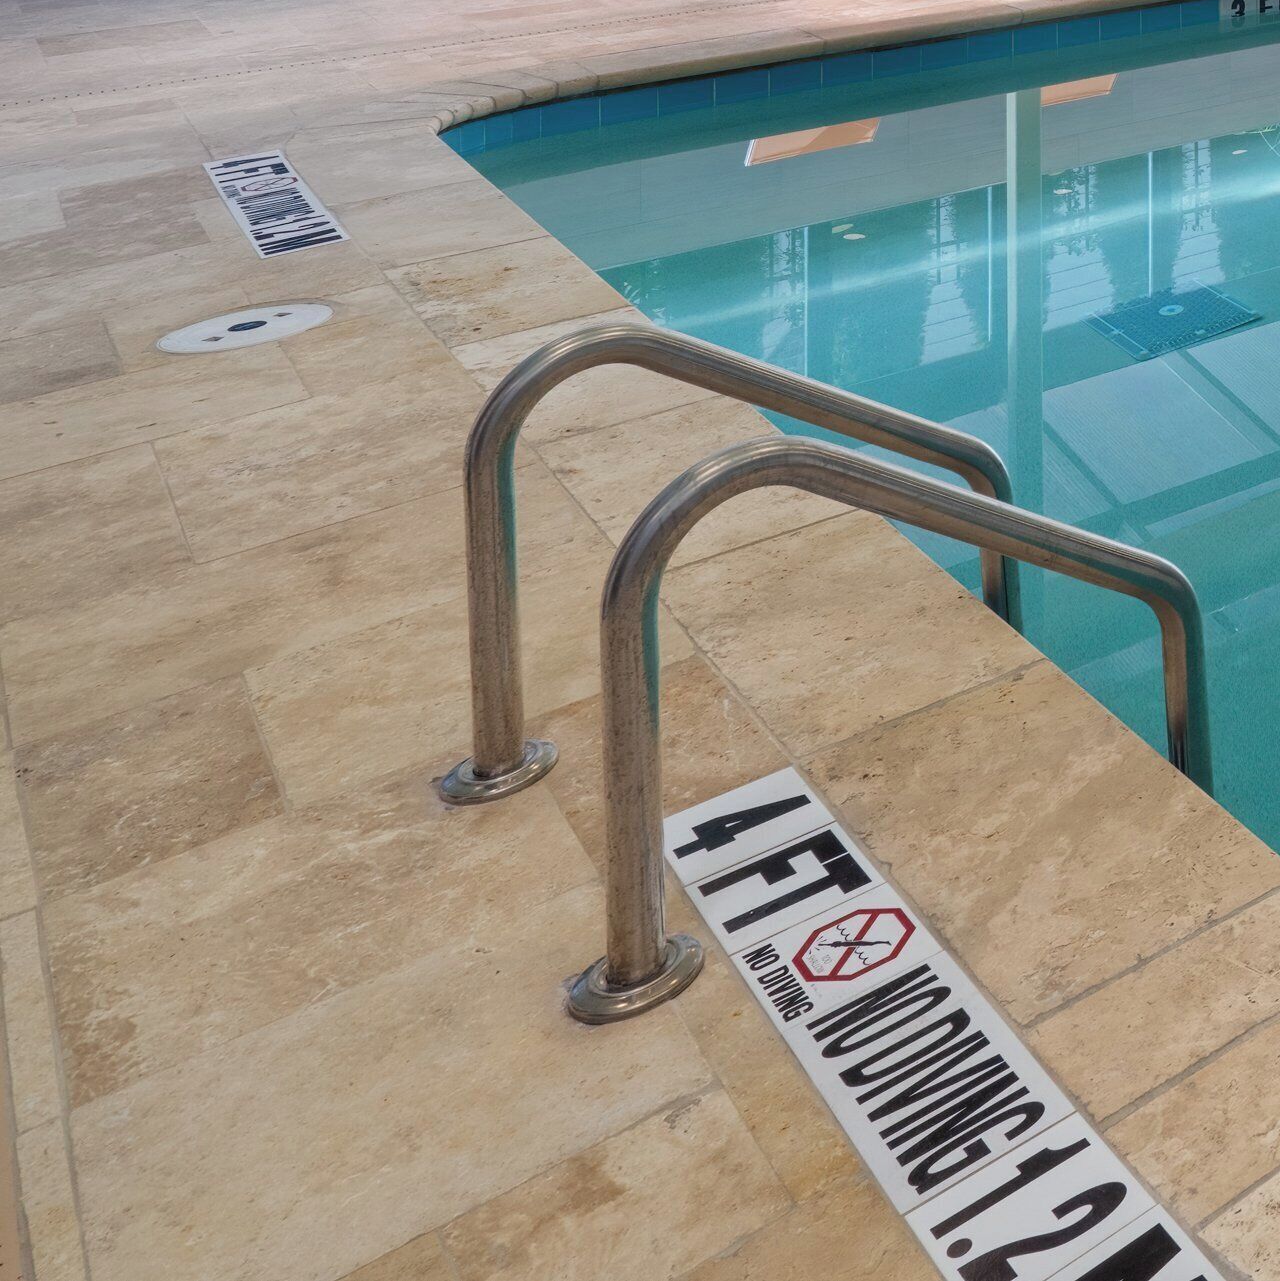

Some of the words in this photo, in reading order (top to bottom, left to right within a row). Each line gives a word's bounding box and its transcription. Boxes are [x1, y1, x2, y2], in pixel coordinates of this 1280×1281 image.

[258, 227, 343, 256] M
[672, 793, 813, 860] 4
[696, 827, 873, 934] FT
[741, 942, 773, 978] NO
[756, 965, 814, 1024] DIVING
[805, 962, 953, 1060] NO
[838, 1006, 1047, 1196] DIVING
